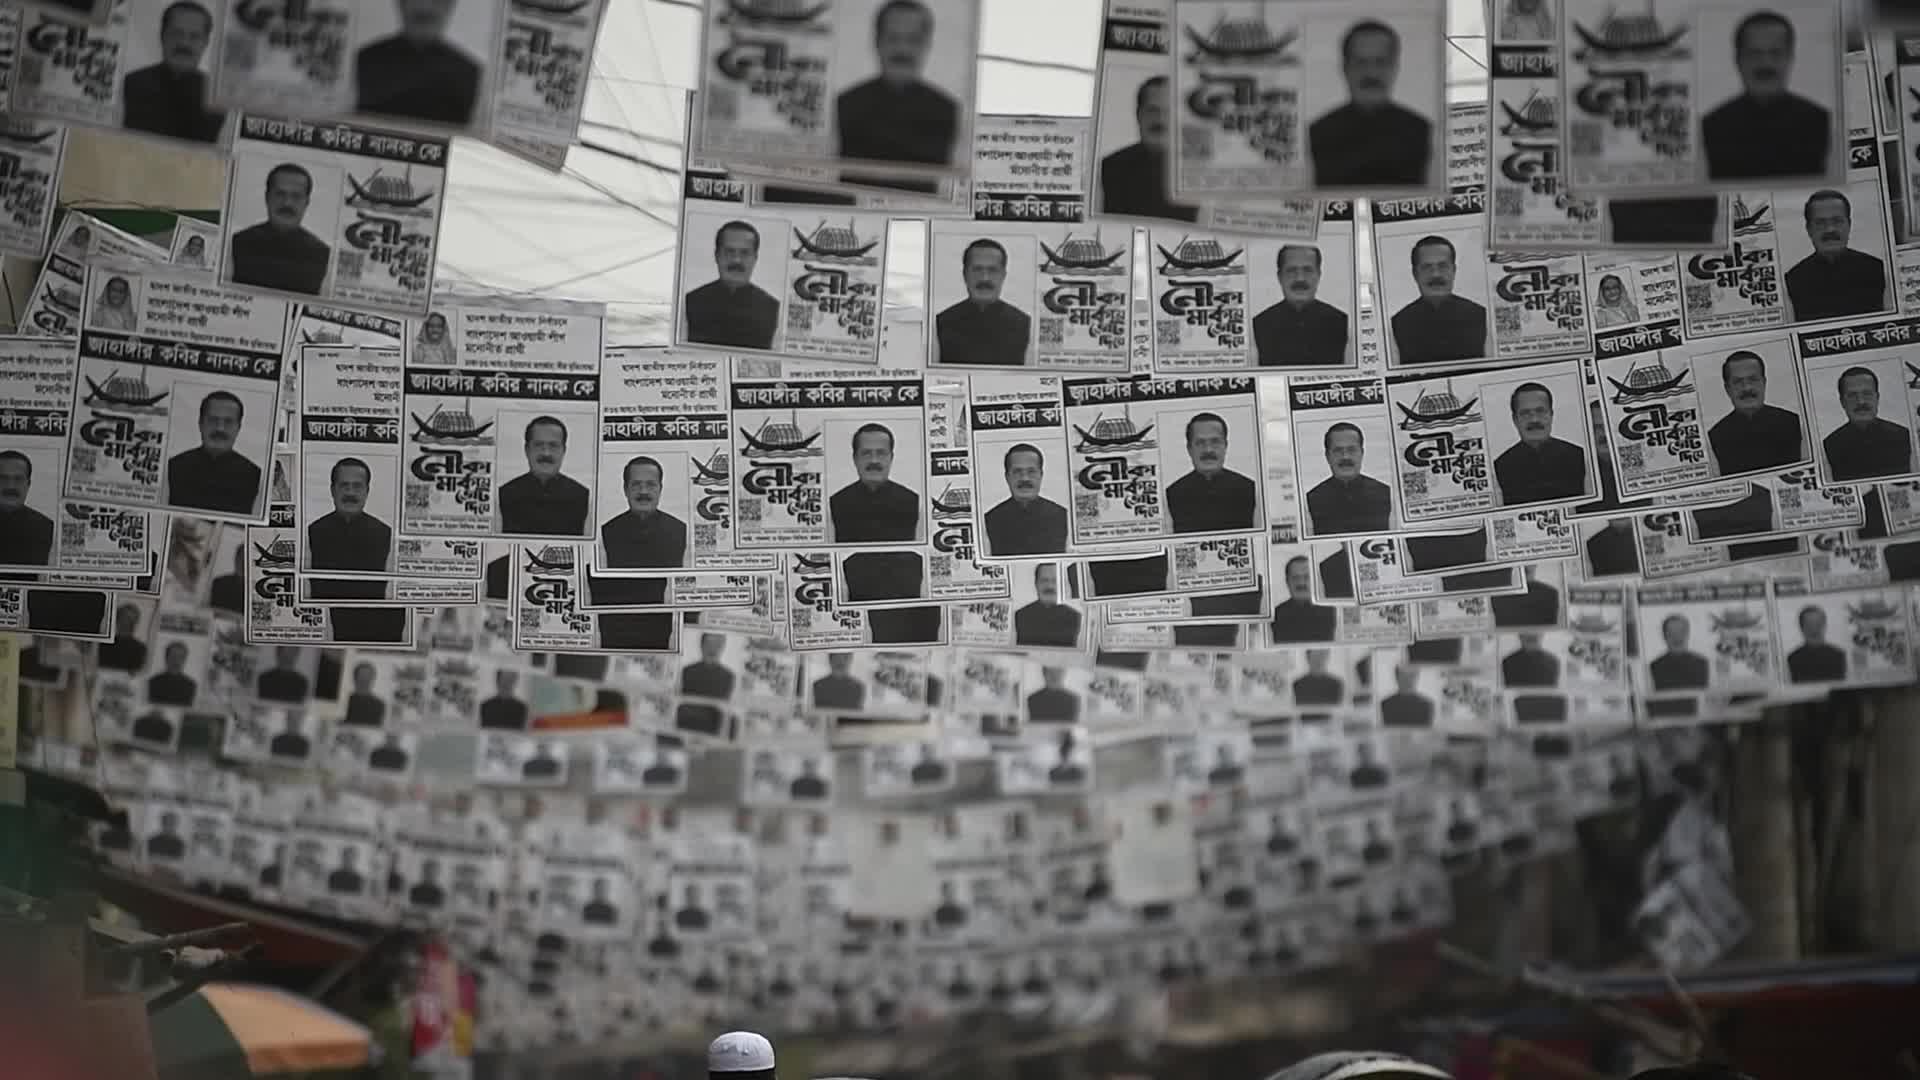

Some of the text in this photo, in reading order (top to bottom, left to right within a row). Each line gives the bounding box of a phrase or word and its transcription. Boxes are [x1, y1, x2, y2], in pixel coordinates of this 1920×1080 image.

[1852, 145, 1873, 164] কে
[1011, 195, 1051, 217] কবির
[1689, 242, 1774, 279] নৌকা
[794, 264, 877, 301] নৌকা
[1496, 265, 1579, 302] নৌকা
[1716, 265, 1775, 288] মার্কায়
[819, 293, 876, 316] মার্কায়
[1043, 277, 1125, 314] নৌকা
[1160, 279, 1243, 316] নৌকা
[1522, 288, 1581, 311] মার্কায়
[1751, 292, 1778, 308] দিয়ে
[1069, 303, 1125, 325] মার্কায়
[1186, 304, 1244, 326] মার্কায়
[1557, 316, 1584, 330] দিয়ে
[847, 323, 875, 340] দিয়ে
[1098, 334, 1125, 348] দিয়ে
[1218, 334, 1245, 348] দিয়ে
[1600, 326, 1661, 351] জাহাঙ্গীর
[1805, 323, 1910, 353] জাহাঙ্গীর কবির
[88, 336, 152, 360] জাহাঙ্গীর
[160, 342, 200, 365] কবির
[205, 354, 249, 370] নানক
[253, 357, 276, 375] কে
[410, 371, 595, 396] জাহাঙ্গীর কবির নানক কে
[737, 383, 919, 404] জাহাঙ্গীর কবির নানক কে
[1068, 376, 1132, 400] জাহাঙ্গীর
[1182, 376, 1223, 391] নানক
[1229, 376, 1250, 391] কে
[1295, 384, 1355, 405] জাহাঙ্গীর
[976, 404, 1036, 426] জাহাঙ্গীর
[1619, 404, 1697, 440] নৌকা
[80, 411, 163, 445] নৌকা
[308, 418, 367, 439] জাহাঙ্গীর
[664, 416, 700, 437] কবির
[1646, 424, 1700, 447] মার্কায়
[104, 438, 161, 461] মার্কায়
[1404, 431, 1483, 466] নৌকা
[1679, 450, 1705, 463] দিয়ে
[411, 446, 490, 481] নৌকা
[1078, 456, 1156, 490] নৌকা
[1431, 453, 1486, 475] মার্কায়
[132, 470, 159, 485] দিয়ে
[435, 471, 491, 491] মার্কায়
[742, 460, 821, 495] নৌকা
[1463, 478, 1489, 492] দিয়ে
[767, 485, 822, 504] মার্কায়
[1104, 479, 1158, 500] মার্কায়
[464, 500, 490, 515] দিয়ে
[1134, 505, 1159, 519] দিয়ে
[797, 512, 822, 526] দিয়ে
